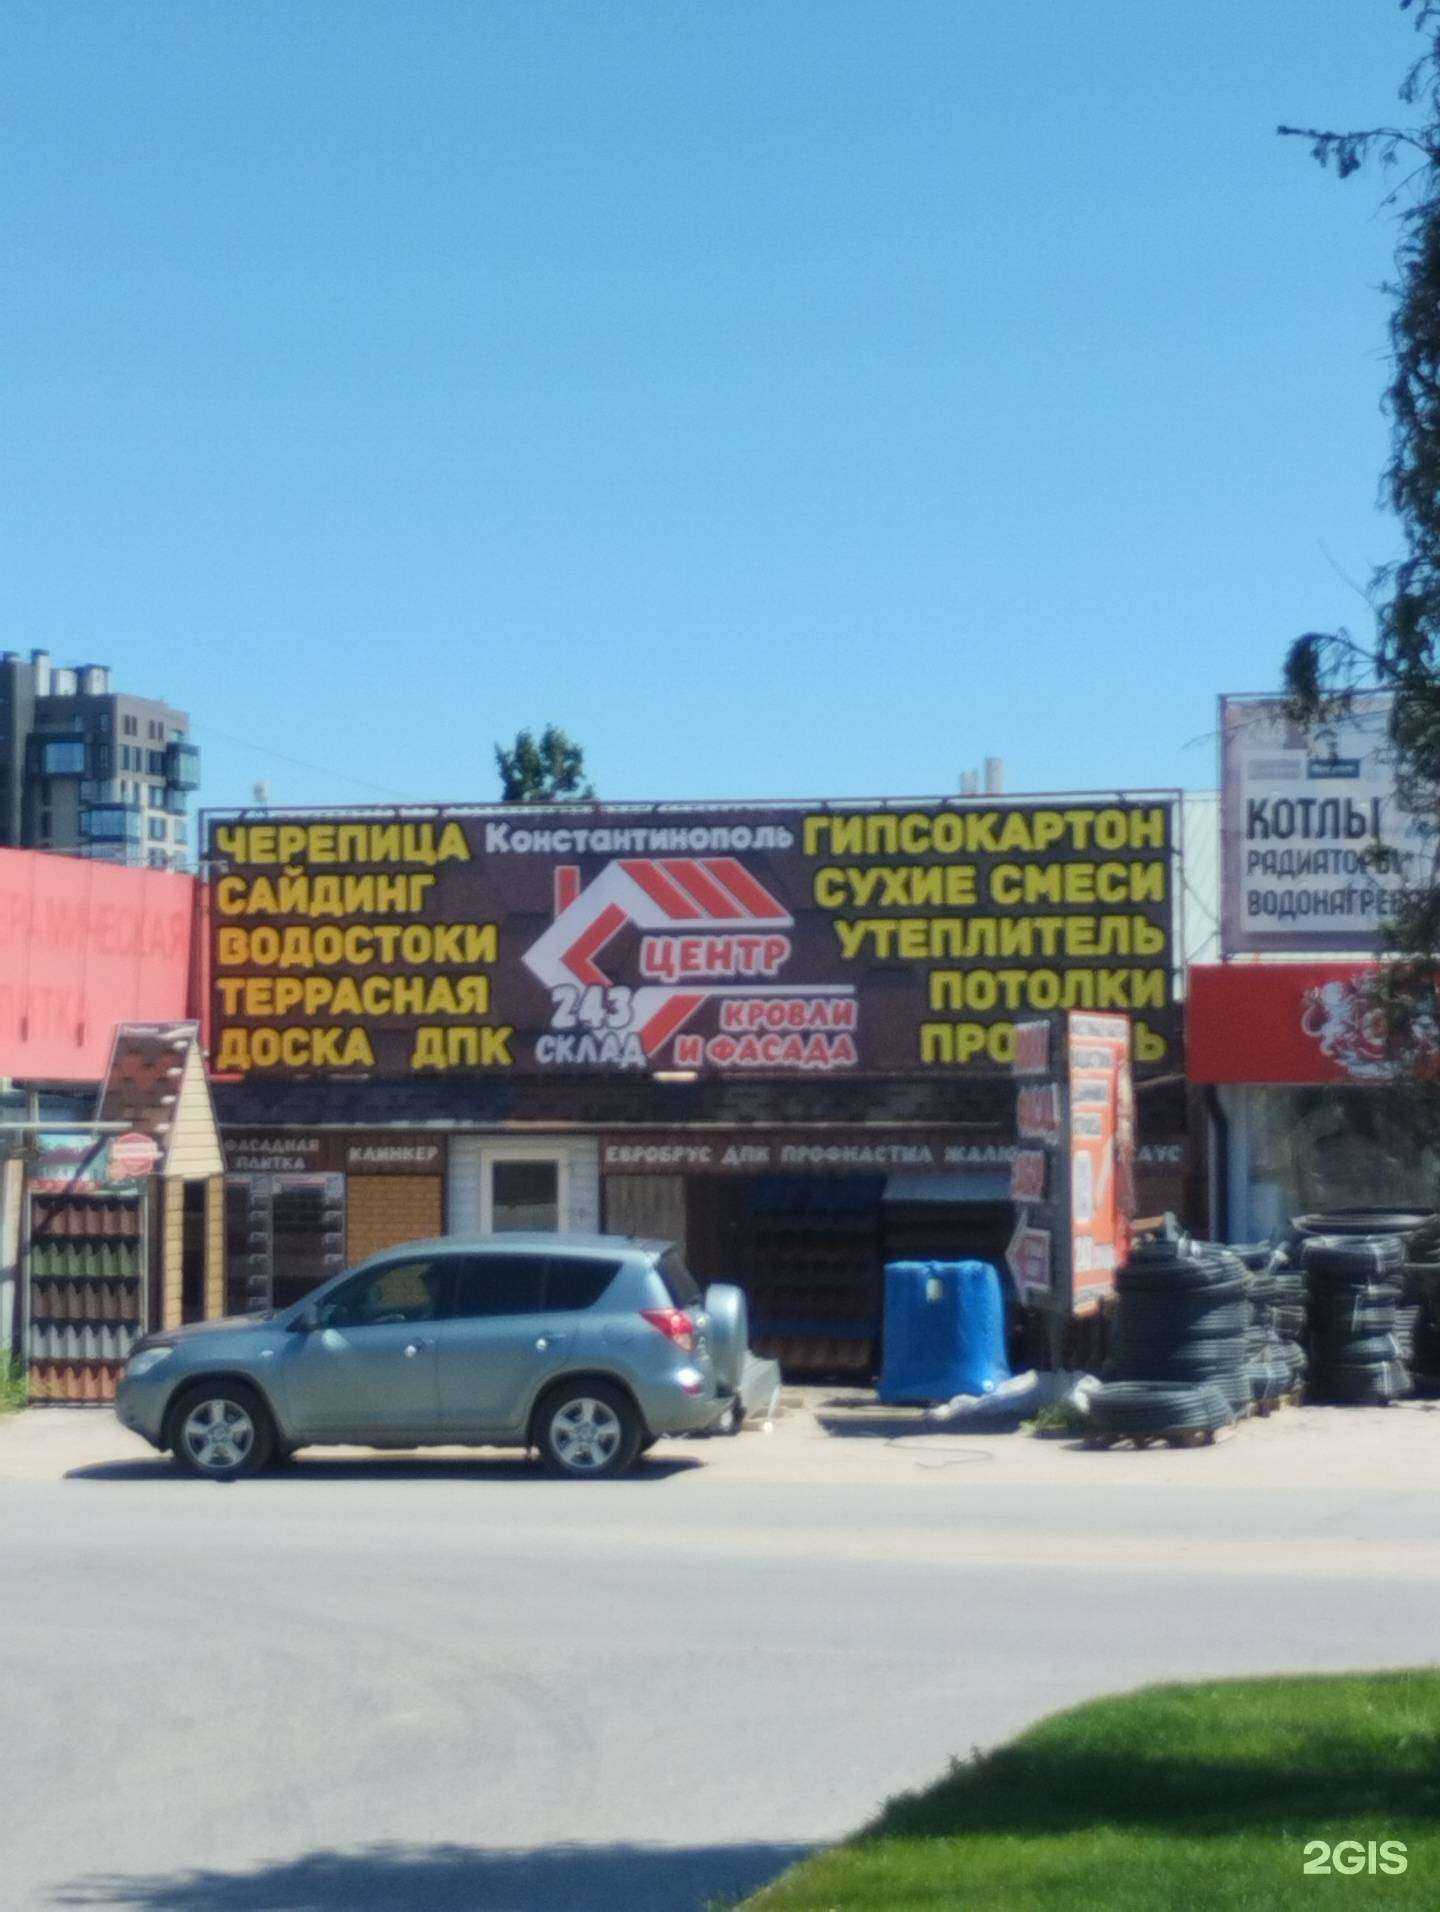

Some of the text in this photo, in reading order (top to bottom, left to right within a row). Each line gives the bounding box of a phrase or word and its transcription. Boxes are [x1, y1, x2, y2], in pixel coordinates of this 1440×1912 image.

[803, 808, 1165, 856] ГИПСОКАРТОН
[1246, 797, 1380, 840] КОТЛЫ
[216, 822, 470, 865] ЧЕРЕПИЦА
[216, 866, 435, 917] САЙДИНГ
[814, 861, 1166, 909] СУХИЕ СМЕСИ
[217, 924, 497, 968] ВОДОСТОКИ
[640, 934, 792, 981] ЦЕНТР
[834, 914, 1166, 960] УТЕПЛИТЕЛЬ
[217, 976, 489, 1016] ТЕРРАСНАЯ
[550, 985, 634, 1030] 243
[930, 968, 1166, 1011] ПОТОЛКИ
[720, 999, 858, 1031] КРОВЛИ
[217, 1026, 514, 1070] ДОСКА ДПК
[534, 1033, 647, 1069] СКЛАД
[674, 1033, 858, 1069] И ФАСАДА
[920, 1021, 1168, 1065] ПРОЬ
[606, 1145, 712, 1163] ЕВРОБРУС
